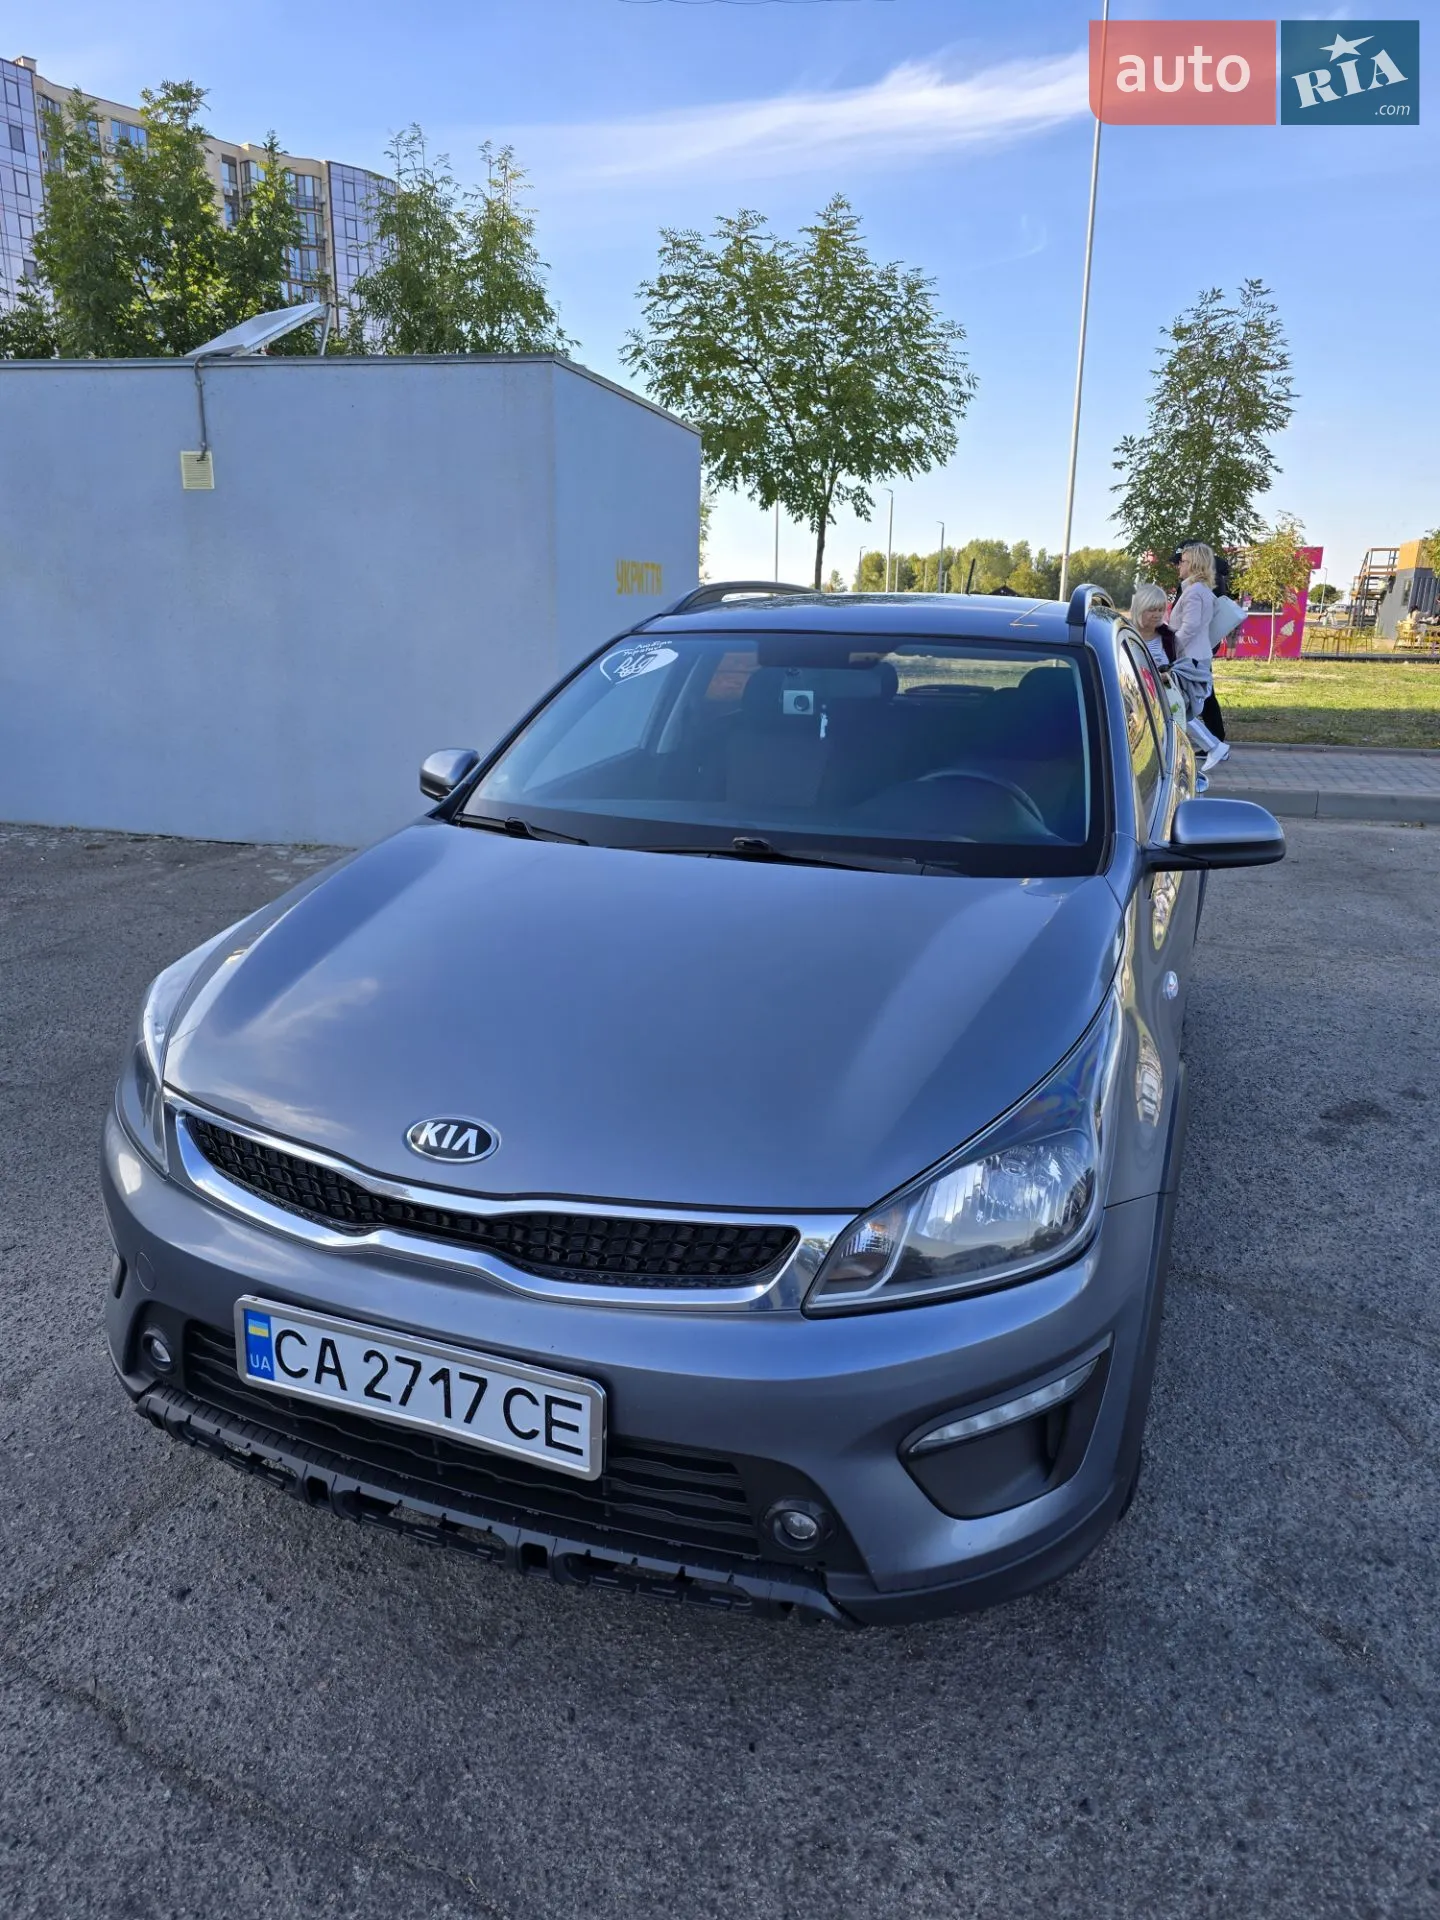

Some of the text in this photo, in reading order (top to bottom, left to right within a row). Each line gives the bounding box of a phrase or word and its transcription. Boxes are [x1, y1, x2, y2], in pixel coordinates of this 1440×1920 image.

[417, 1121, 479, 1155] KIA
[249, 1353, 272, 1373] UA
[274, 1328, 584, 1457] CA 2717 CE
